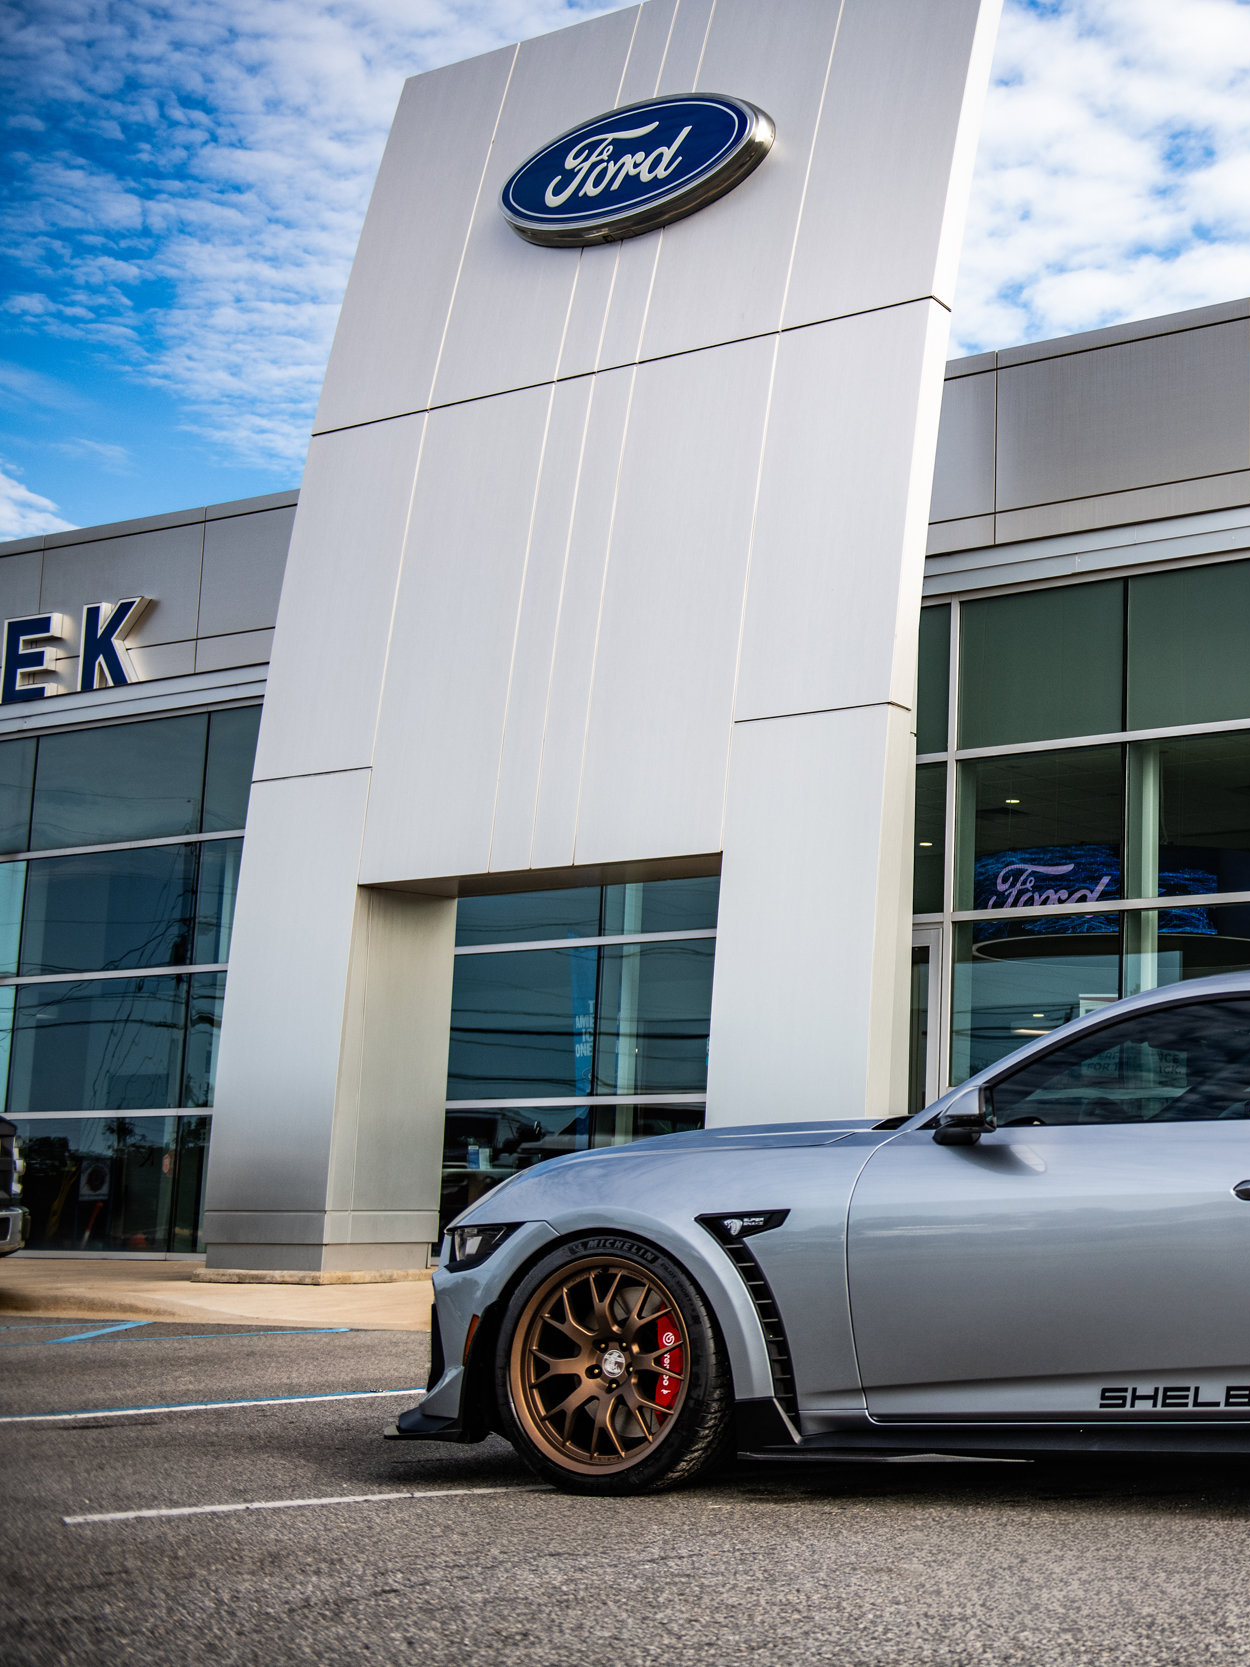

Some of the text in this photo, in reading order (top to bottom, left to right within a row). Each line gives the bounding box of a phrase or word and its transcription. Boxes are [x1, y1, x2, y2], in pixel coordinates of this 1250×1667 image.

[544, 121, 692, 208] Ford
[0, 596, 146, 704] EK
[987, 863, 1112, 918] Ford
[587, 1239, 655, 1262] MICHELIN
